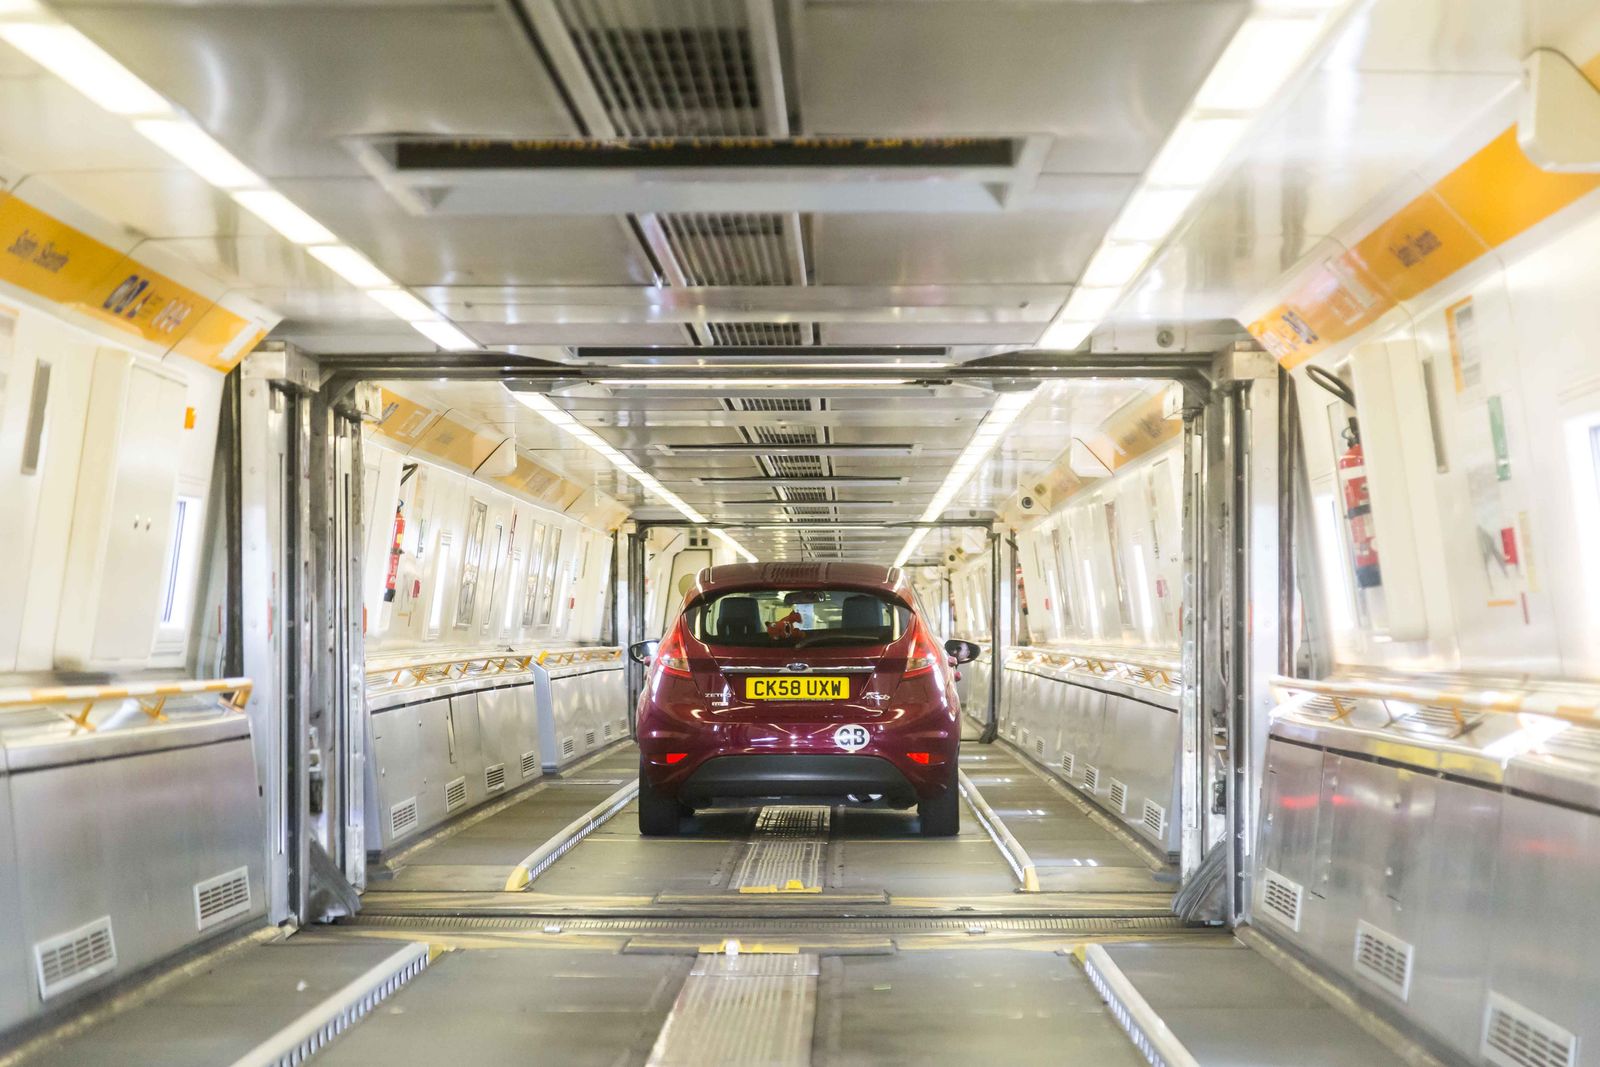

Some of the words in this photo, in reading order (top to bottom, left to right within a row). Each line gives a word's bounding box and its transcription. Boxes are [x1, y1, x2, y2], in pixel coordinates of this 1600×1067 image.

[754, 680, 801, 696] CK58
[807, 680, 841, 696] UXW
[839, 728, 865, 745] GB
